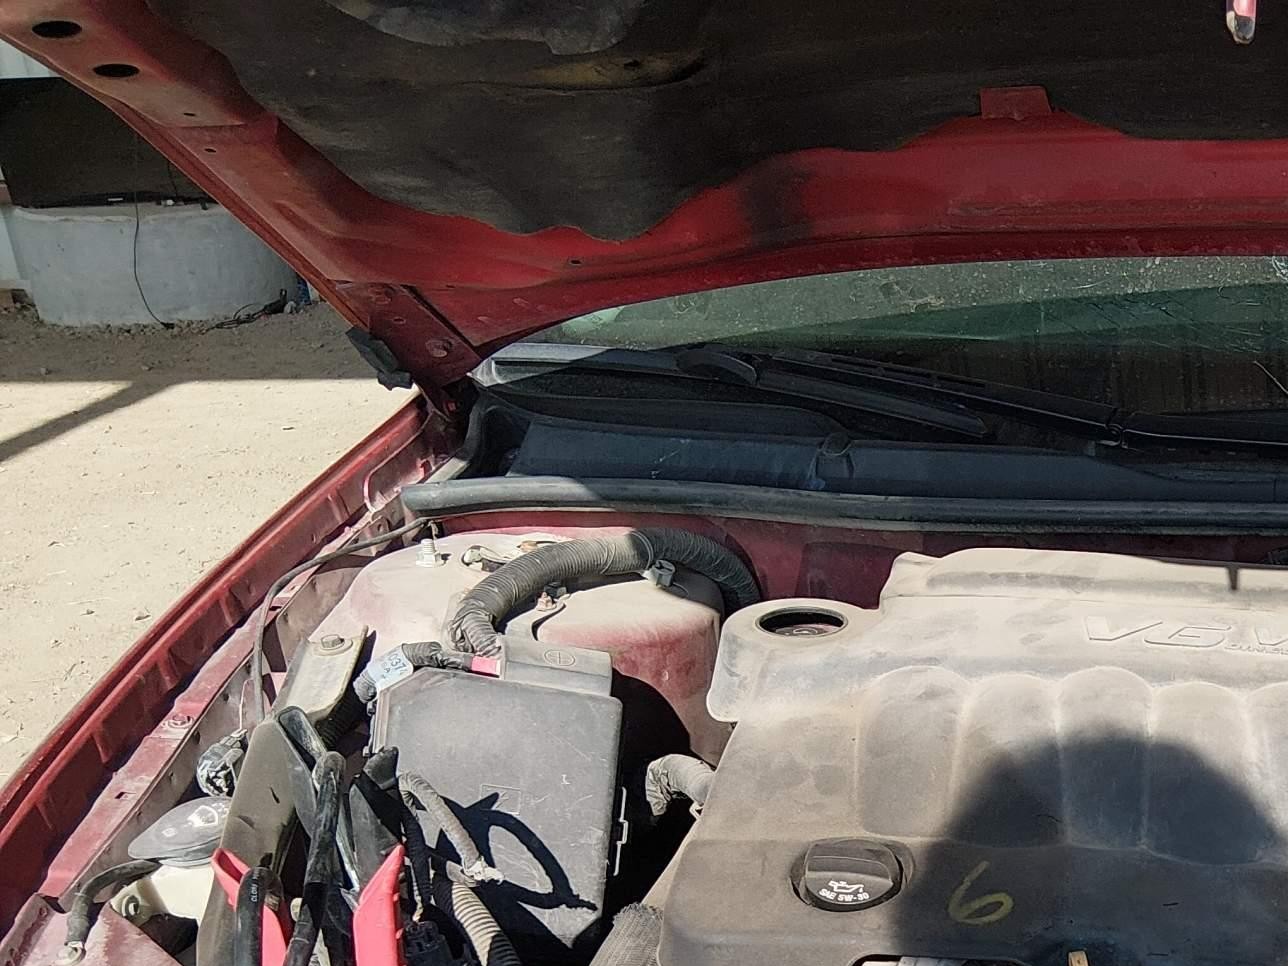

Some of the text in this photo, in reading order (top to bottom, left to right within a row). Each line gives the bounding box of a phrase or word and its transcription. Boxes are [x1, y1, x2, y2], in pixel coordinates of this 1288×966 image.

[1084, 615, 1232, 648] V6
[818, 888, 870, 903] SAE 5W-30
[947, 860, 1015, 925] 6
